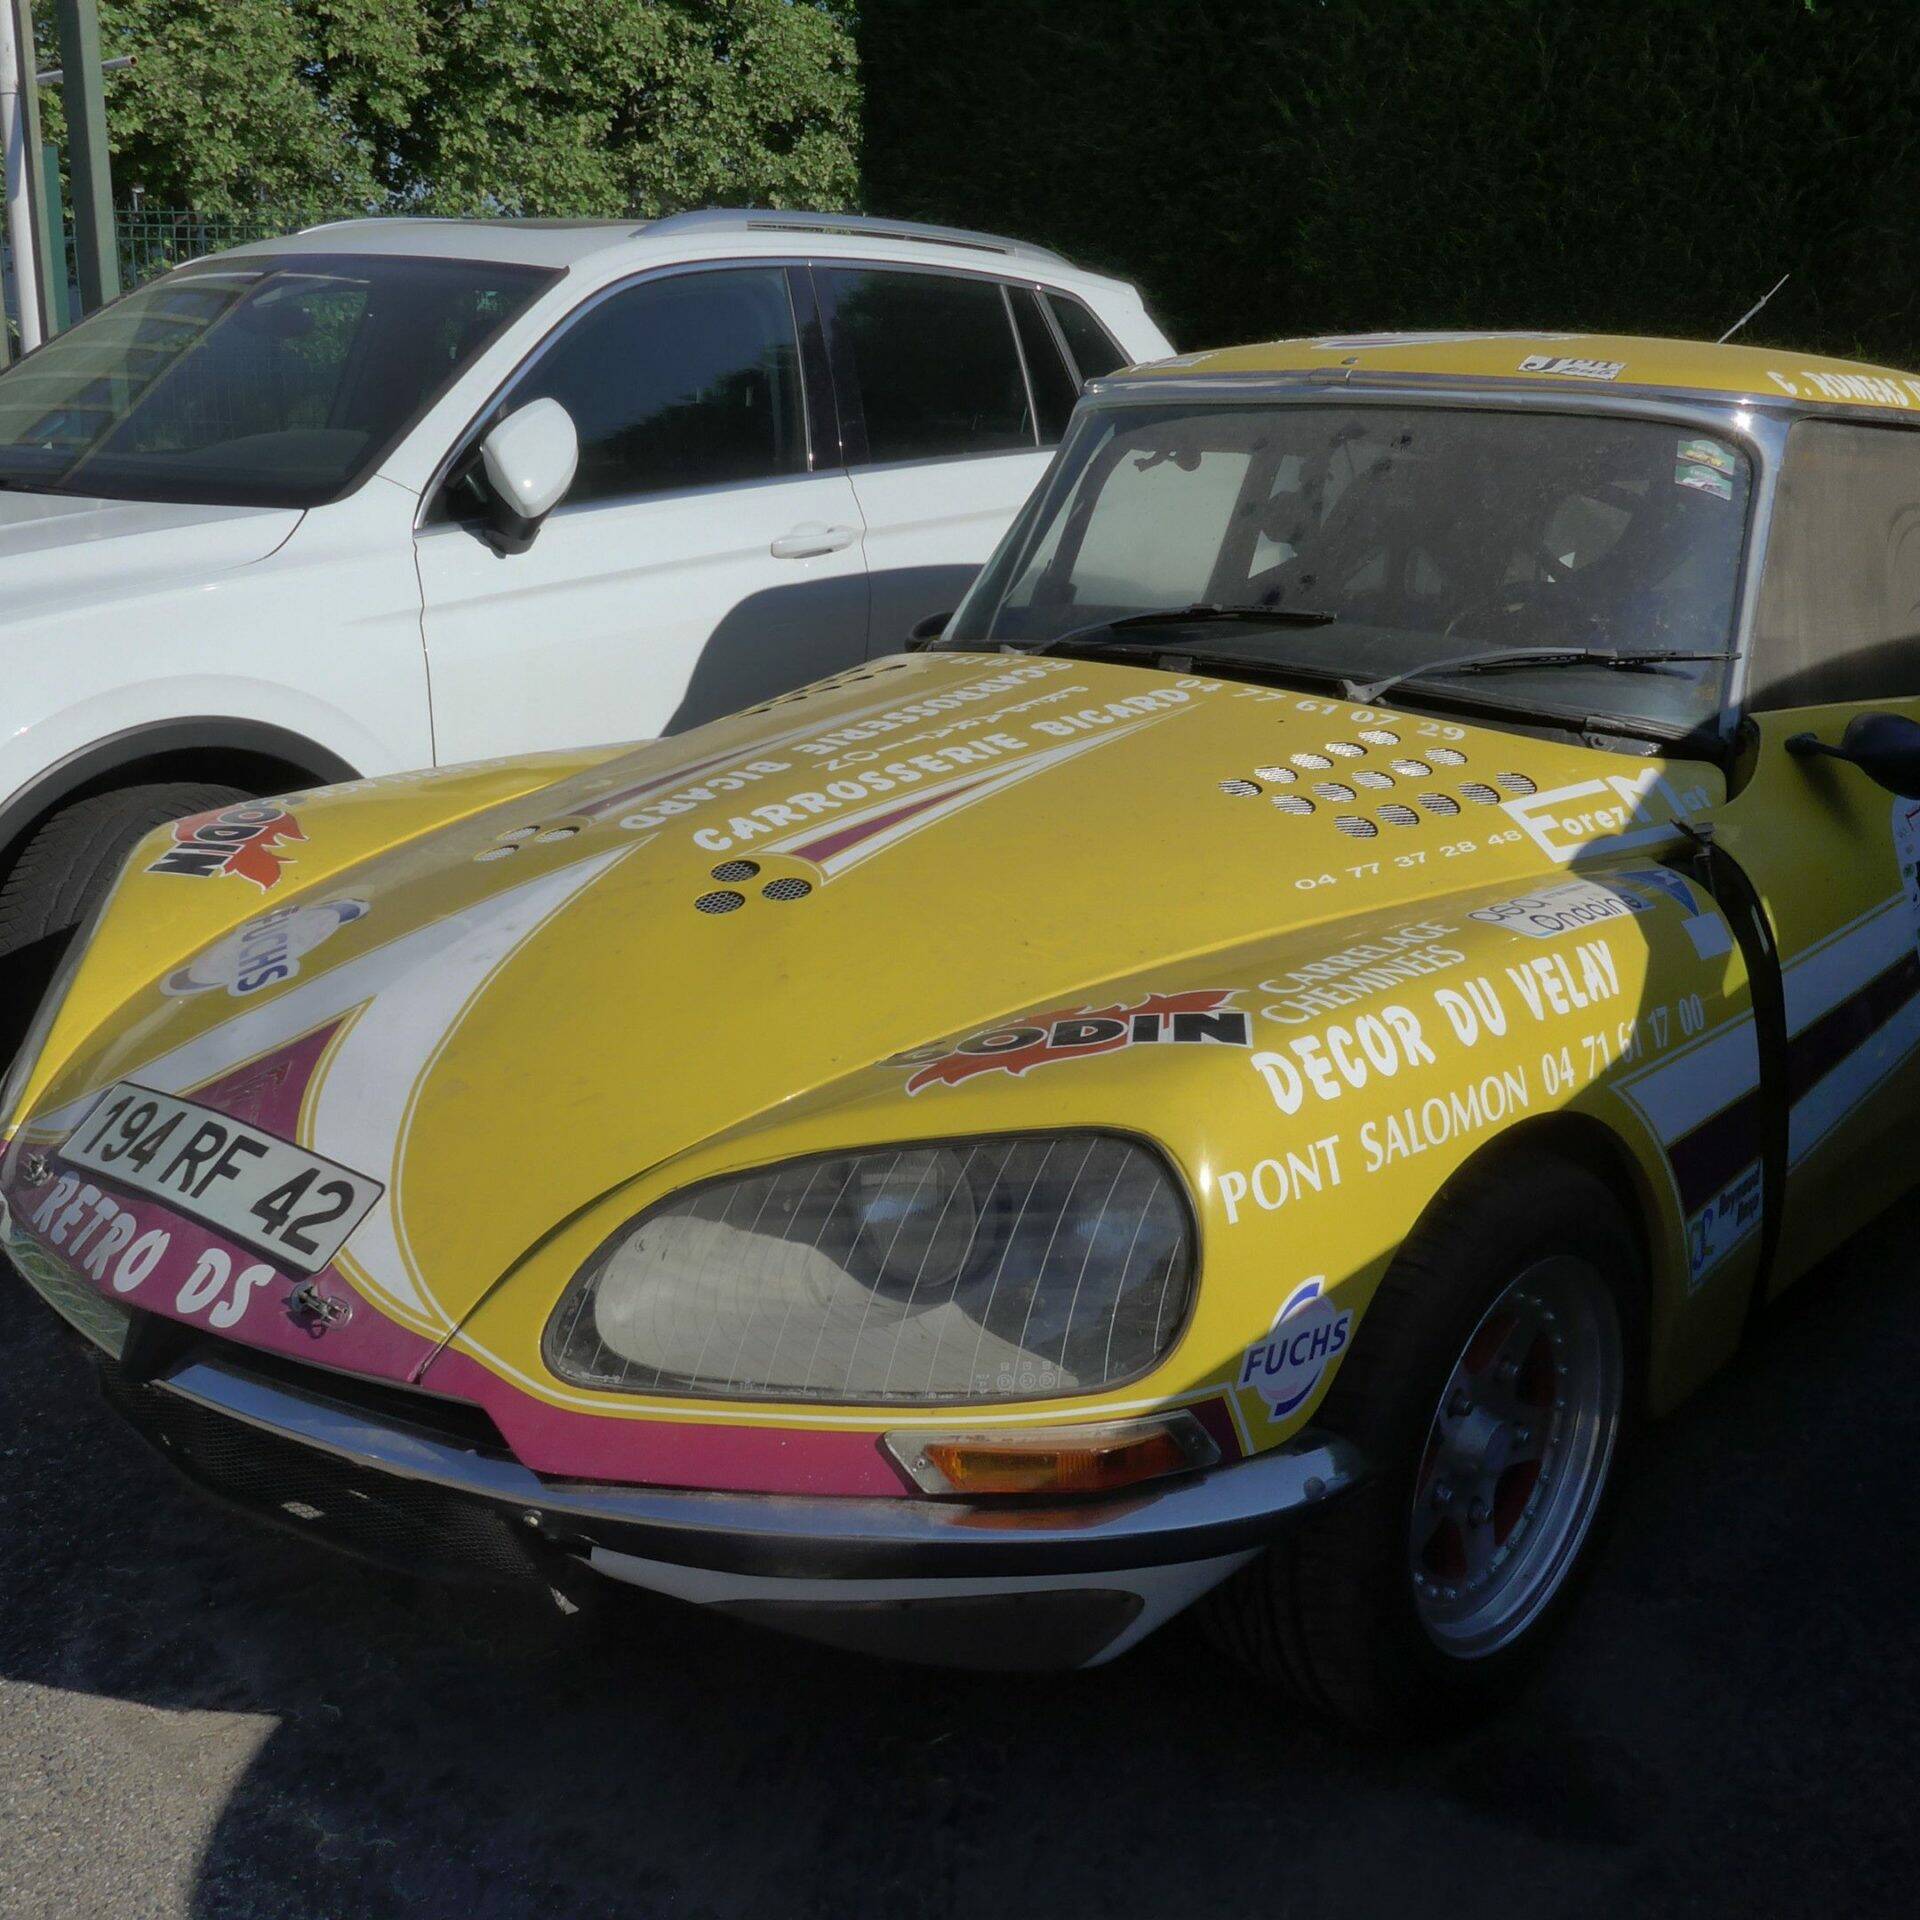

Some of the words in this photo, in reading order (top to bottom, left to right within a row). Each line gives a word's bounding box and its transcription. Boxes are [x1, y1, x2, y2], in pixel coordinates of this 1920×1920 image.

[792, 668, 1048, 755] CARROSSERIE
[1232, 688, 1287, 702] 77
[1296, 700, 1339, 715] 61
[1350, 711, 1401, 726] 07
[1416, 722, 1466, 741] 29
[619, 761, 792, 830] BICARD
[693, 733, 1029, 851] CARROSSERIE
[1031, 689, 1190, 737] BICARD
[1295, 874, 1337, 890] 04
[1345, 862, 1380, 878] 77
[1394, 851, 1426, 867] 37
[1440, 841, 1477, 857] 28
[1488, 830, 1522, 845] 48
[1258, 921, 1460, 994] CARRELAGE
[1260, 944, 1465, 1024] CHEMINEES
[1250, 1004, 1435, 1116] DECOR
[1434, 976, 1508, 1047] DU
[1505, 939, 1621, 1021] VELAY
[1216, 1135, 1341, 1225] PONT
[1360, 1065, 1529, 1173] SALOMON
[1542, 1047, 1574, 1096] 04
[1581, 1031, 1613, 1080] 71
[1617, 1017, 1643, 1064] 61
[1648, 1005, 1669, 1049] 17
[1679, 993, 1704, 1036] 00
[82, 1095, 188, 1174] 194
[158, 1120, 268, 1199] RF
[250, 1169, 355, 1256] 42
[32, 1170, 170, 1293] RETRO
[175, 1248, 276, 1329] DS
[1243, 1317, 1349, 1383] FUCHS
